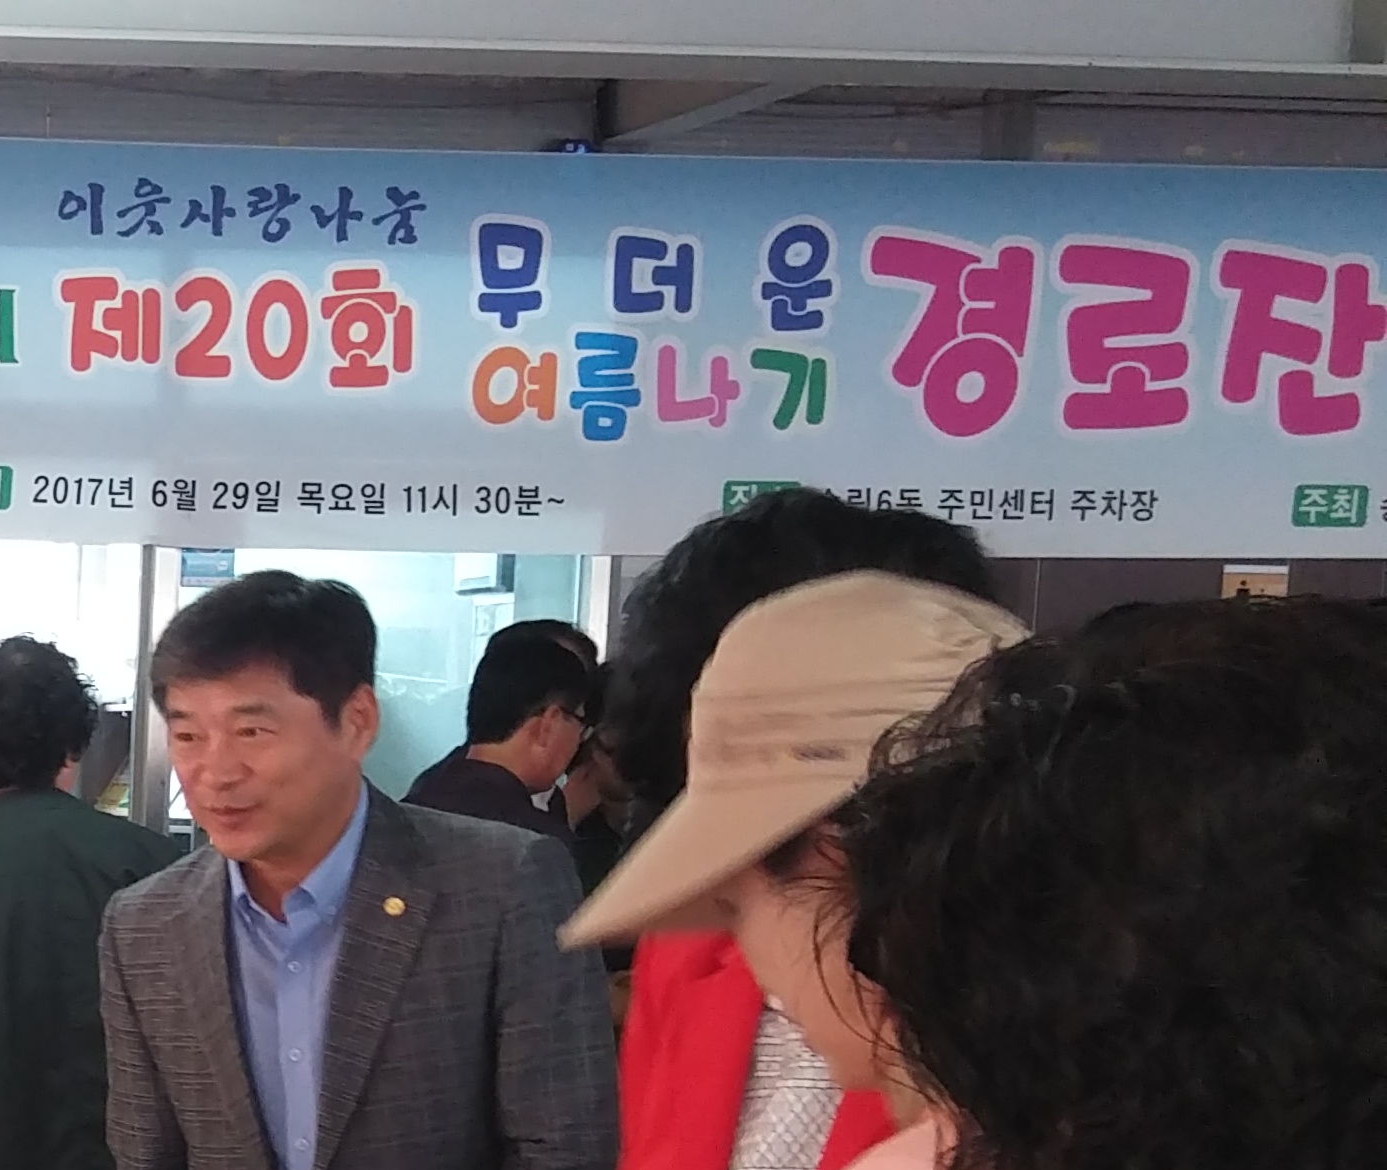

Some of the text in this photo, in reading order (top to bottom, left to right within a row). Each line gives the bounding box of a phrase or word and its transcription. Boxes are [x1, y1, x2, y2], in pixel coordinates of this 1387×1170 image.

[58, 176, 428, 246] 이웃사랑나눔
[60, 268, 413, 389] 제20회
[472, 332, 828, 442] 여름나기
[32, 475, 565, 517] 2017년 6월 29일 목요일 11시 30분~
[936, 488, 1055, 522] 주민센터
[1070, 489, 1160, 522] 주차장
[1298, 488, 1359, 523] 주최
